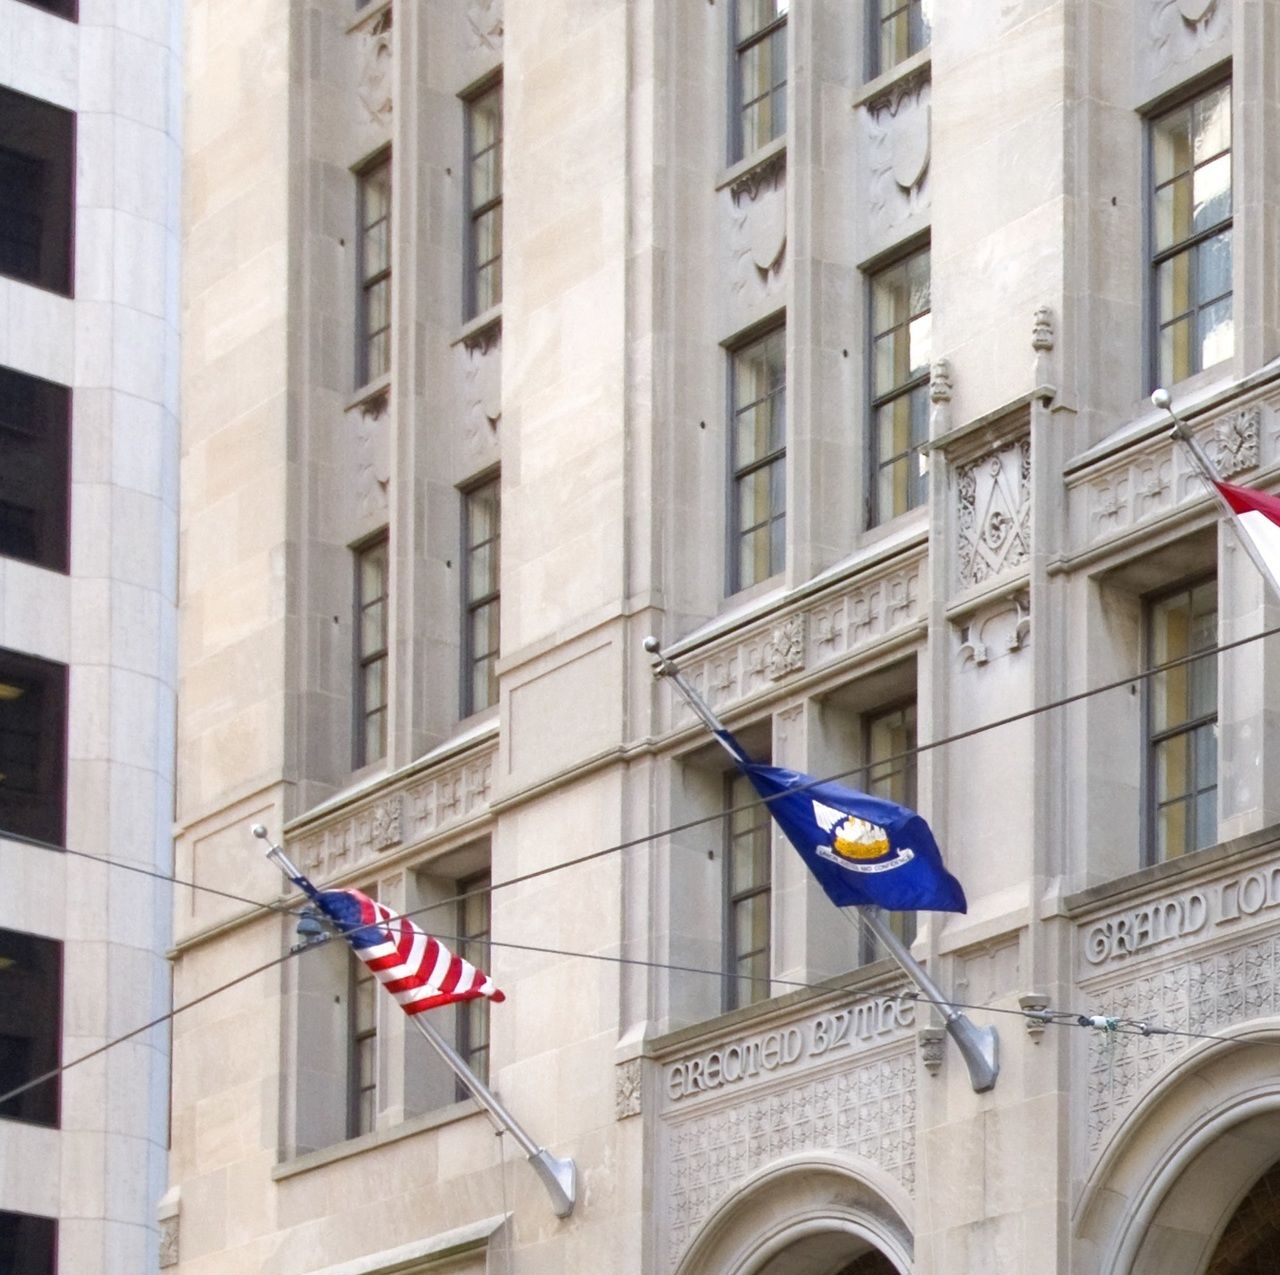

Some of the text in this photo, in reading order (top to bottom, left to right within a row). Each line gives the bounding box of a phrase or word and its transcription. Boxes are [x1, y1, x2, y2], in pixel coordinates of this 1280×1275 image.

[1084, 893, 1207, 964] GRAND
[667, 1027, 802, 1101] ERECTED
[808, 1008, 852, 1058] BY
